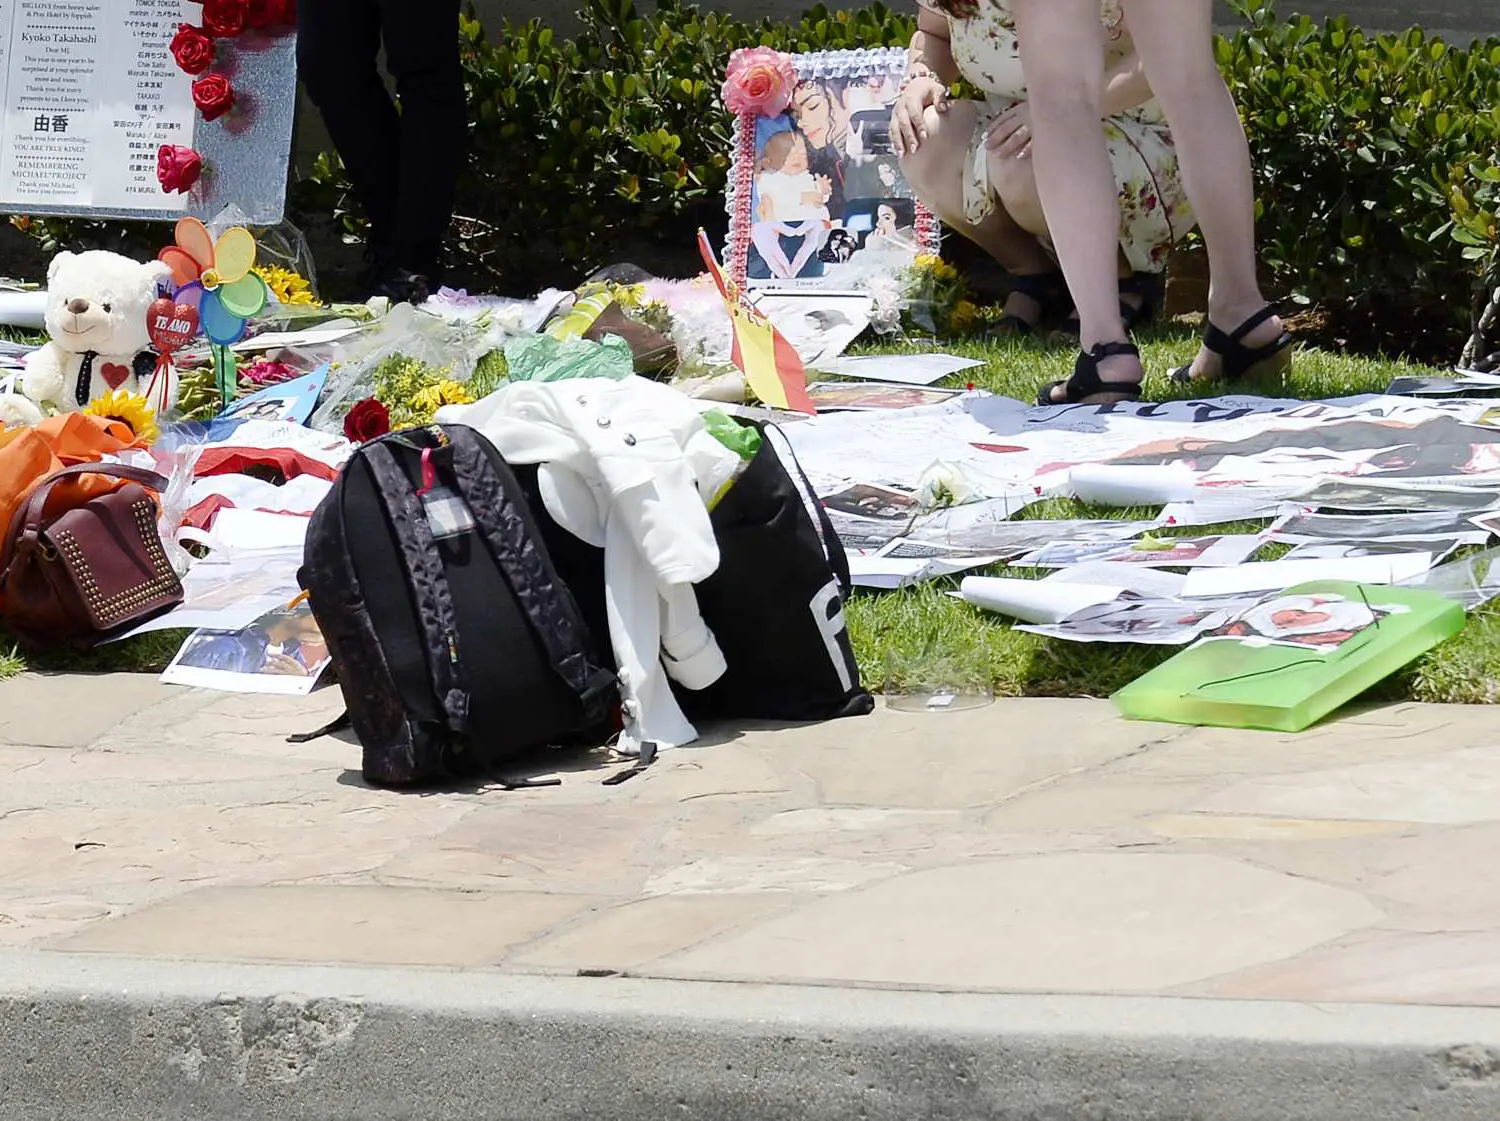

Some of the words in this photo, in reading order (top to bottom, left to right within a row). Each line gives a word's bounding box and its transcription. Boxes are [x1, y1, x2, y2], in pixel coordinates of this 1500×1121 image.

[22, 32, 51, 44] Kyoko
[53, 34, 97, 44] Takahashi
[34, 114, 69, 132] 由香
[19, 162, 78, 170] REMEMBERING
[154, 315, 168, 330] TE
[167, 319, 191, 334] AMO
